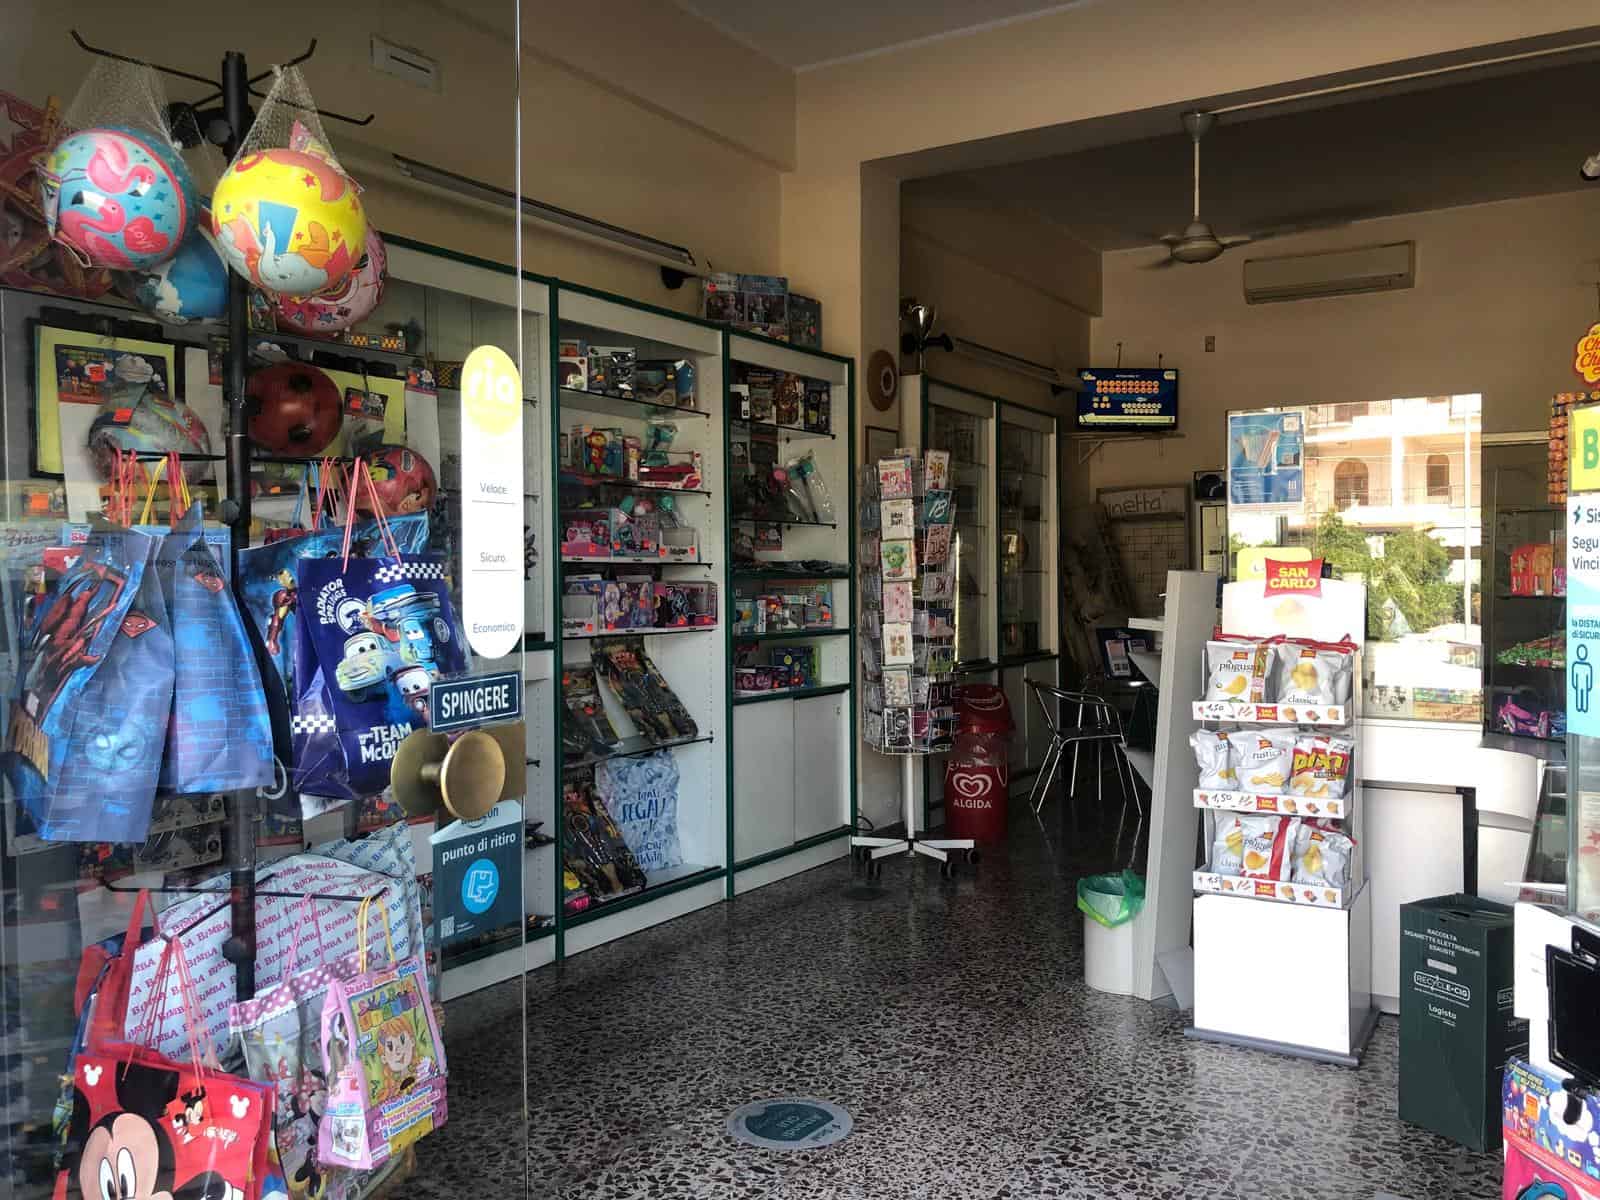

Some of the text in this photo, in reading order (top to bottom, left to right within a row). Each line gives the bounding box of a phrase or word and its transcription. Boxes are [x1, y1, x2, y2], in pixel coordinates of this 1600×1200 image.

[468, 358, 516, 402] ria
[1582, 427, 1600, 470] B
[479, 482, 508, 495] Veloce
[480, 551, 506, 563] Sicuro
[1278, 567, 1309, 578] SAN
[1269, 578, 1318, 589] CARLO
[317, 578, 344, 625] RADIATOR
[472, 622, 516, 634] Economico
[441, 684, 509, 719] SPINGERE
[370, 722, 413, 743] TEAM
[360, 740, 401, 763] McQU
[953, 799, 992, 809] ALGIDA
[1211, 792, 1233, 804] 1,50
[441, 831, 516, 865] punto di ritiro
[1427, 928, 1457, 942] RACCOLTA
[1428, 1003, 1457, 1019] Logista
